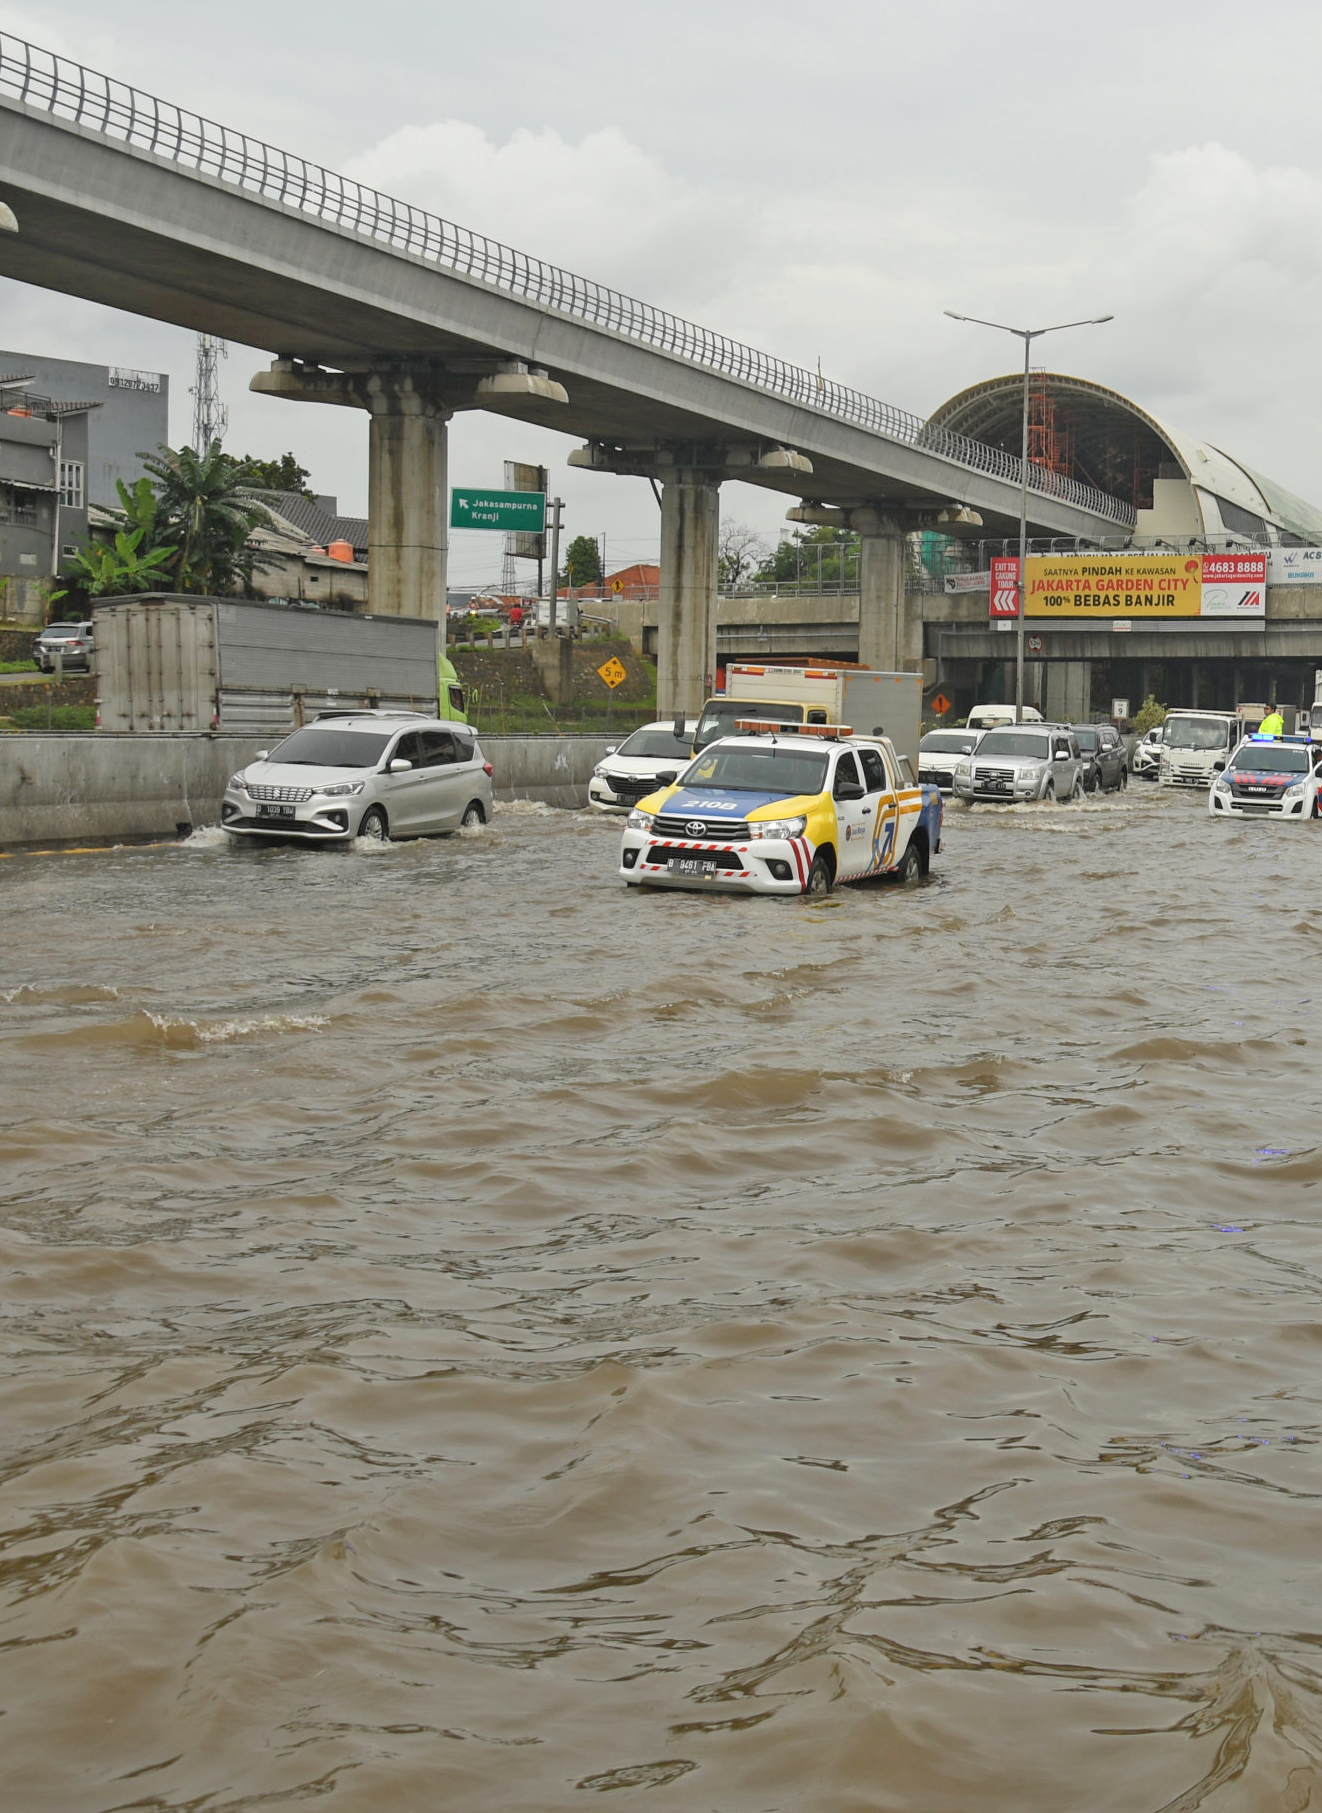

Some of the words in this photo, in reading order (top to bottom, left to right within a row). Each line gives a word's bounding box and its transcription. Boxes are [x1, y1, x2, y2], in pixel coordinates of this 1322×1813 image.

[473, 500, 537, 510] Jakasampurna
[472, 512, 499, 522] Kranji
[995, 563, 1006, 571] EXIT
[1008, 563, 1017, 571] TOL
[1082, 567, 1122, 575] PINDAH
[1209, 562, 1234, 573] 4683
[1238, 562, 1263, 572] 8888
[995, 572, 1016, 580] CAKUNG
[1030, 580, 1092, 594] JAKARTA
[1096, 579, 1154, 591] GARDEN
[1158, 579, 1189, 591] CITY
[1043, 595, 1070, 606] 100%
[1074, 595, 1120, 606] BEBAS
[1125, 595, 1175, 607] BANJIR
[606, 667, 611, 677] 5
[681, 800, 738, 810] 210B
[668, 859, 674, 867] B
[680, 861, 697, 869] 9461
